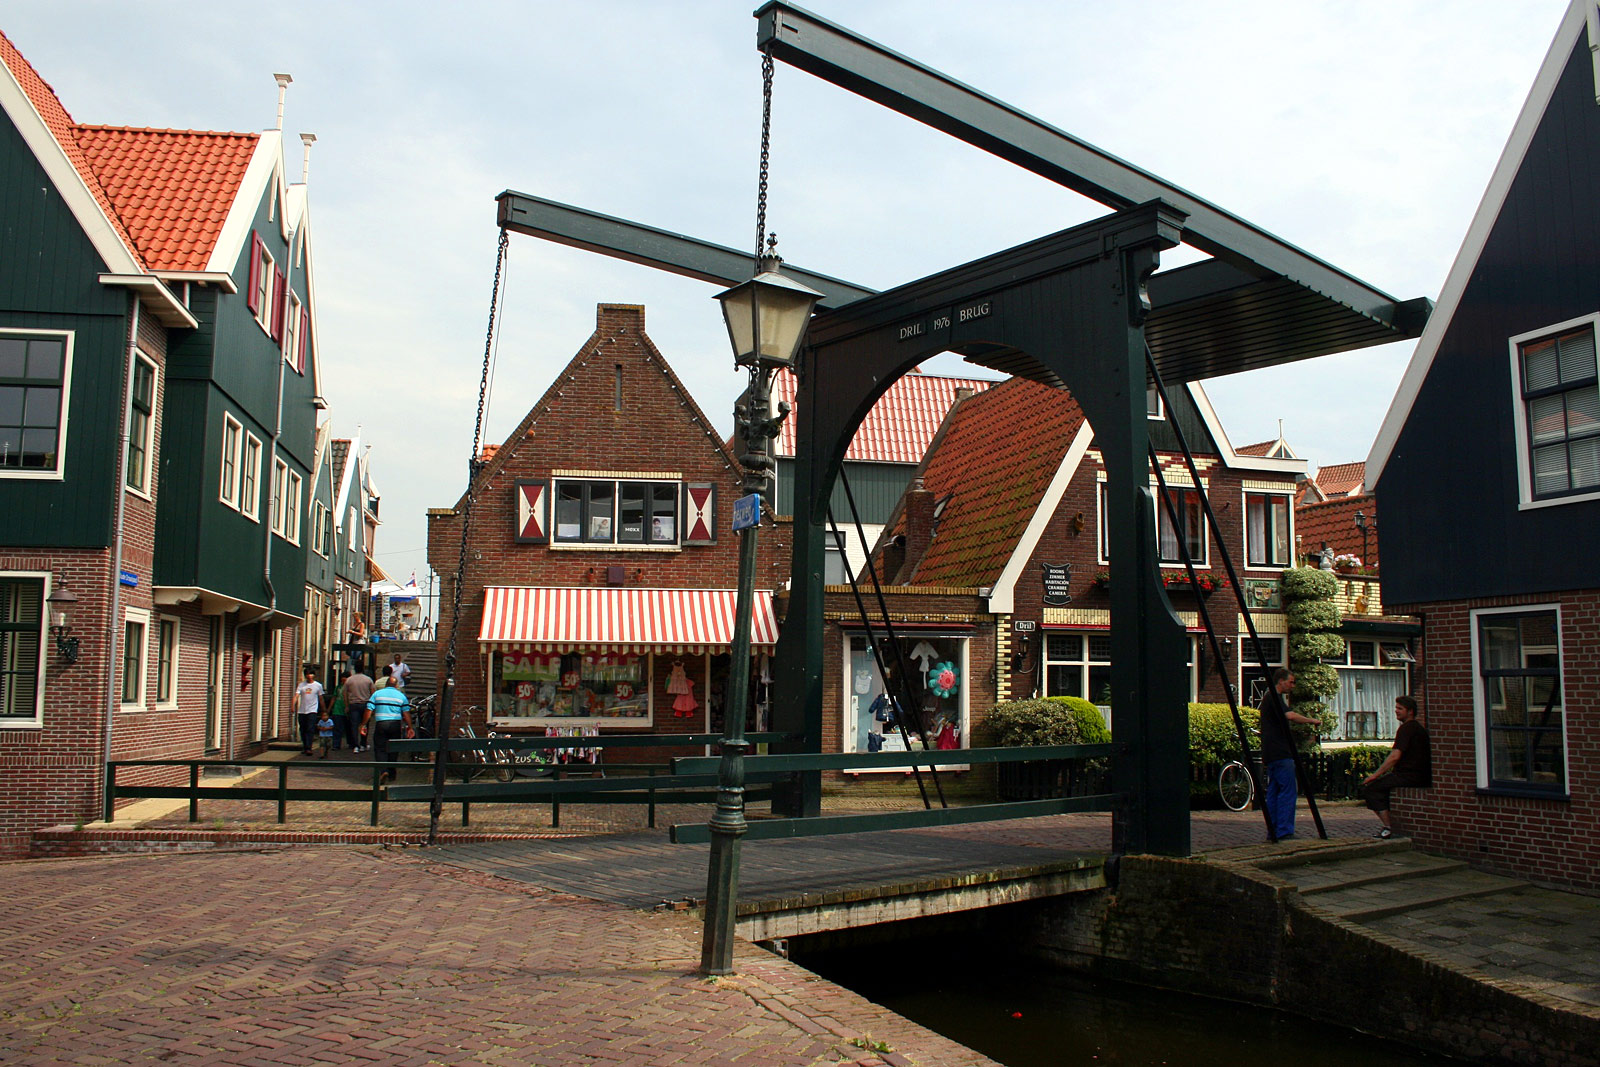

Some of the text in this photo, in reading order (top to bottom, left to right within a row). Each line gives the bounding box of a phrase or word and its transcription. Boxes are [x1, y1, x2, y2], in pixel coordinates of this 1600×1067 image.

[900, 303, 989, 339] DRIL 1976 BRUG
[503, 656, 561, 674] SALE
[515, 756, 532, 764] ZUS
